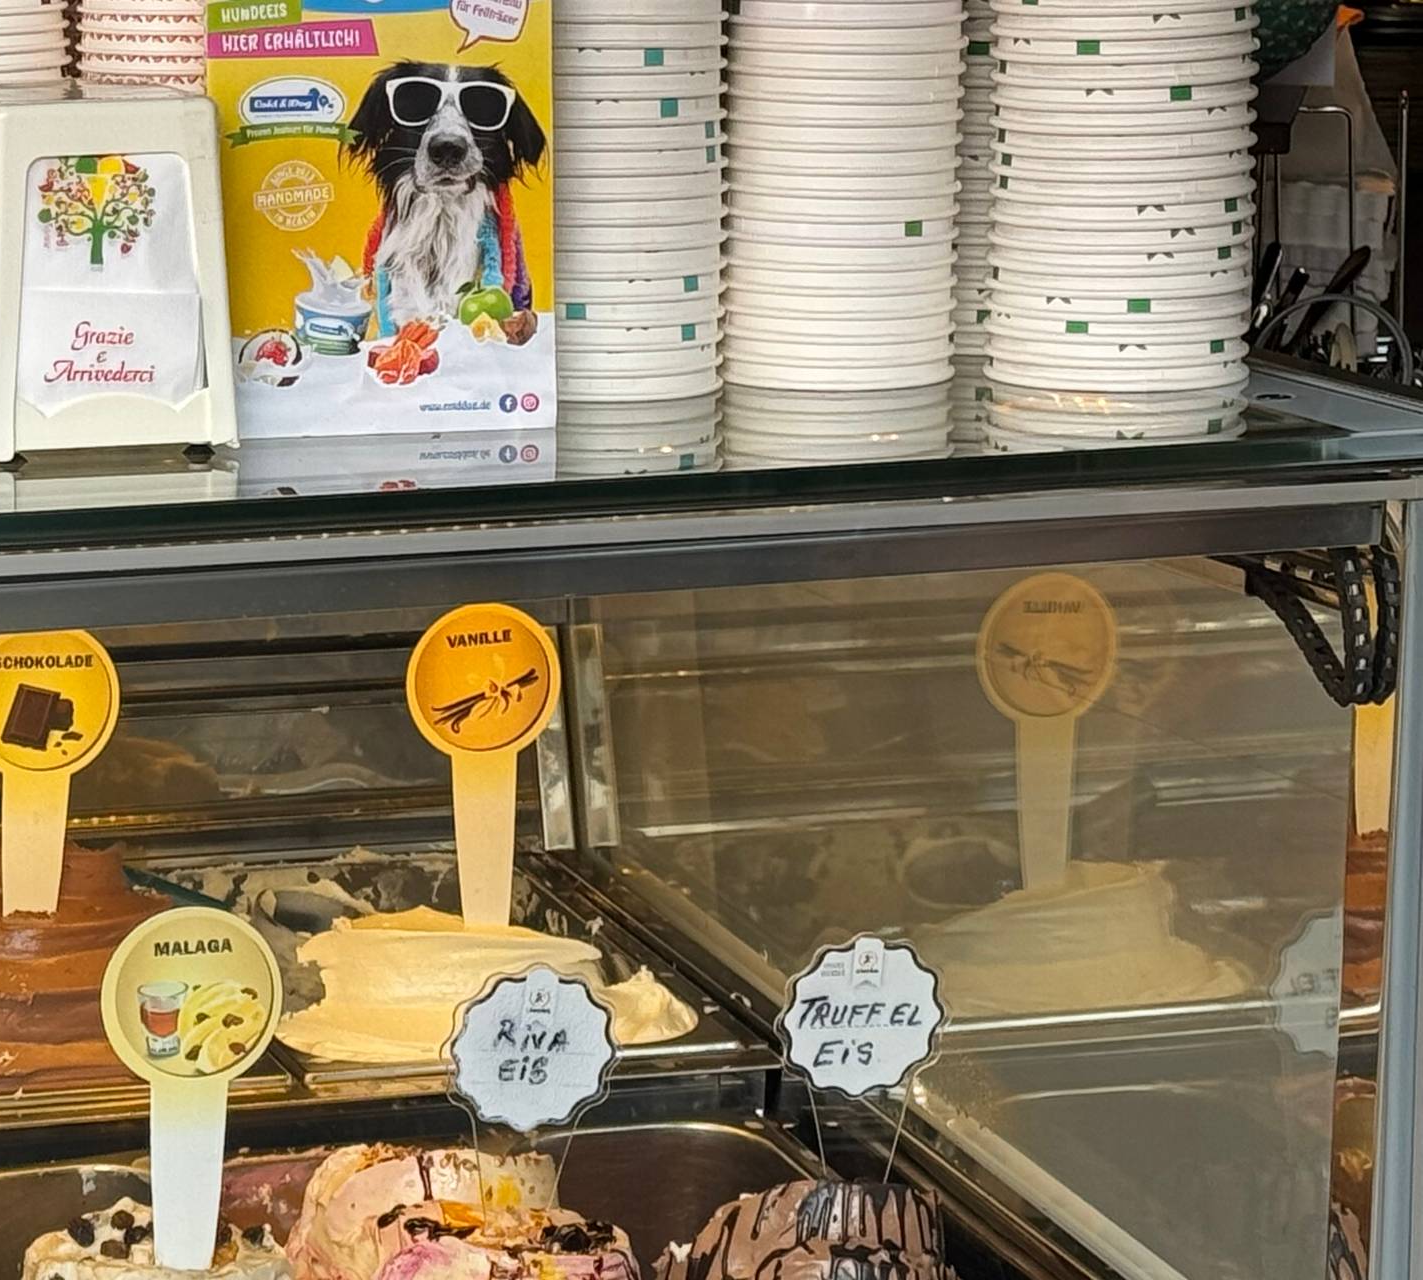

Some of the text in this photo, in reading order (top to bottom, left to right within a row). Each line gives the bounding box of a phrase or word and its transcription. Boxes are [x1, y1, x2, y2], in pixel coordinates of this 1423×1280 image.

[222, 29, 360, 52] HIER ERHÄLTLICH!
[257, 186, 330, 207] HANDMADE
[71, 321, 135, 351] Grazie
[44, 360, 156, 383] Arrivederci
[446, 629, 512, 649] VANILLE
[154, 938, 233, 957] MALAGA
[798, 995, 922, 1029] TRUFFEL
